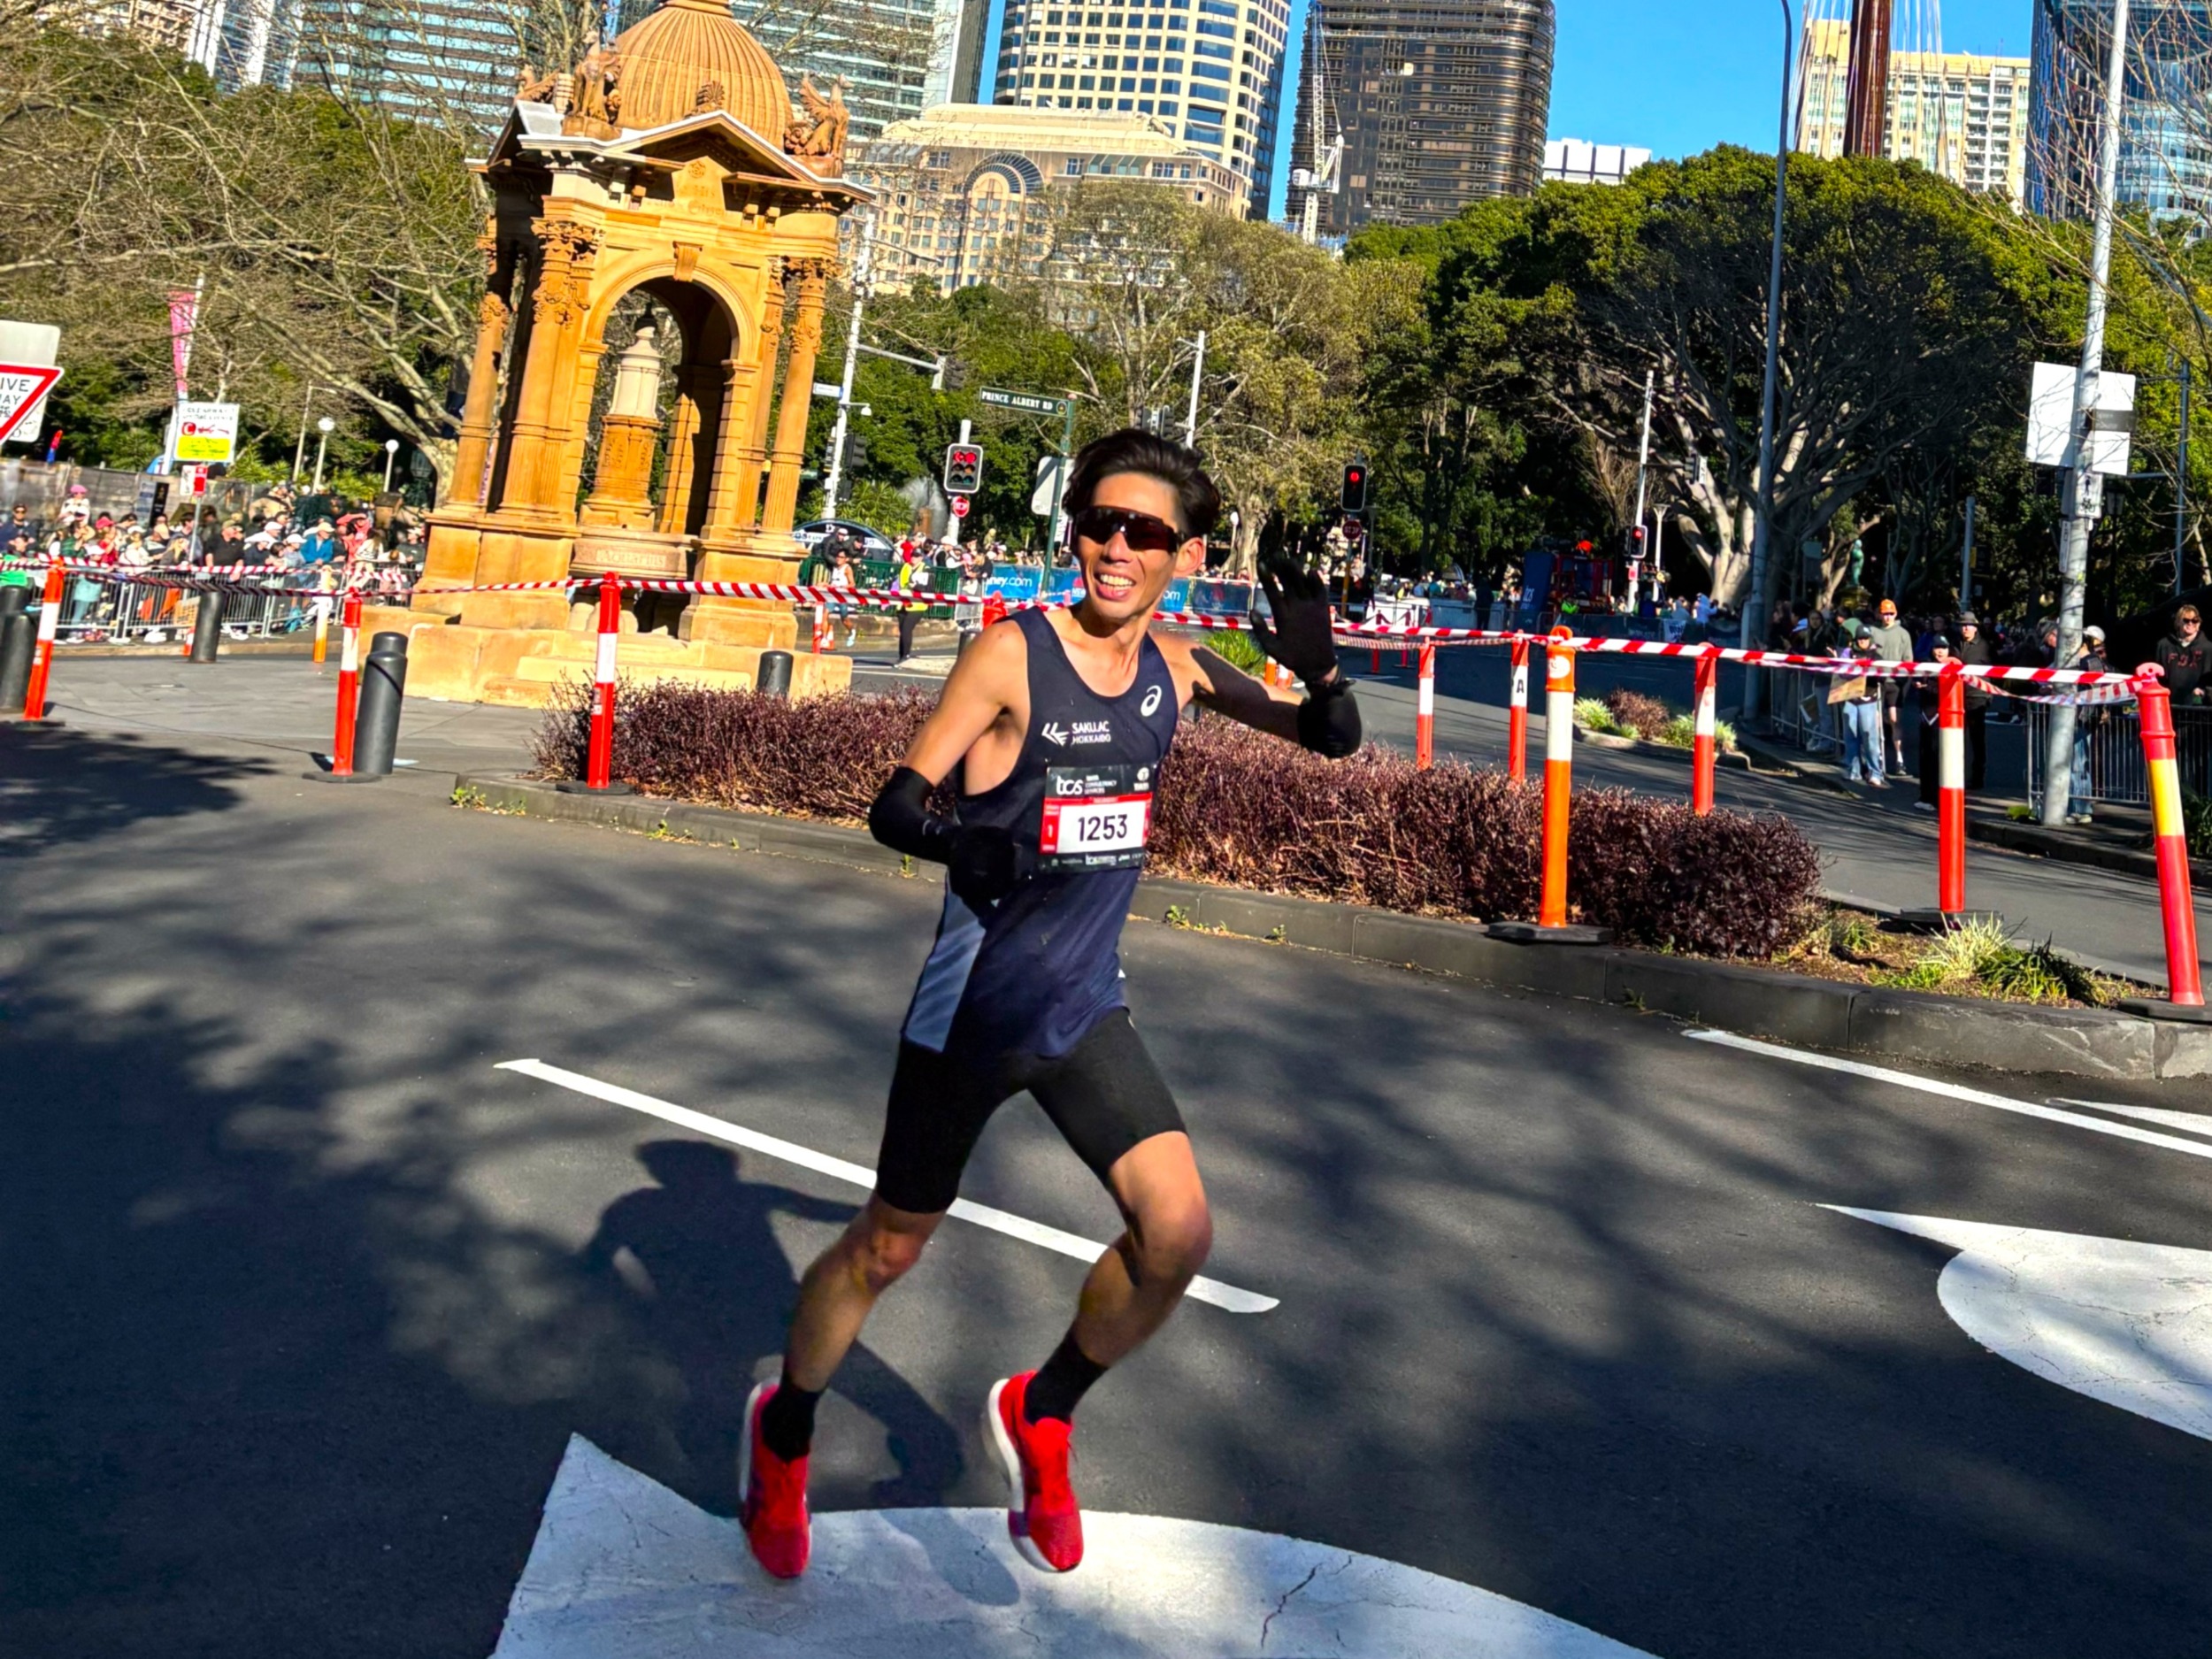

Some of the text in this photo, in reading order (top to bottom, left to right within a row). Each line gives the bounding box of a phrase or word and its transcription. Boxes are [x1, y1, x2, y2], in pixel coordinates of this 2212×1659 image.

[0, 377, 30, 392] IVE
[0, 394, 21, 405] AY
[981, 391, 1053, 411] PRINCE ALBERT RD
[987, 577, 1033, 588] ney.com
[1163, 590, 1180, 602] om
[1515, 679, 1525, 694] A
[1071, 733, 1111, 744] HOKKAIDO
[1056, 775, 1084, 795] tcs
[1078, 814, 1128, 841] 1253
